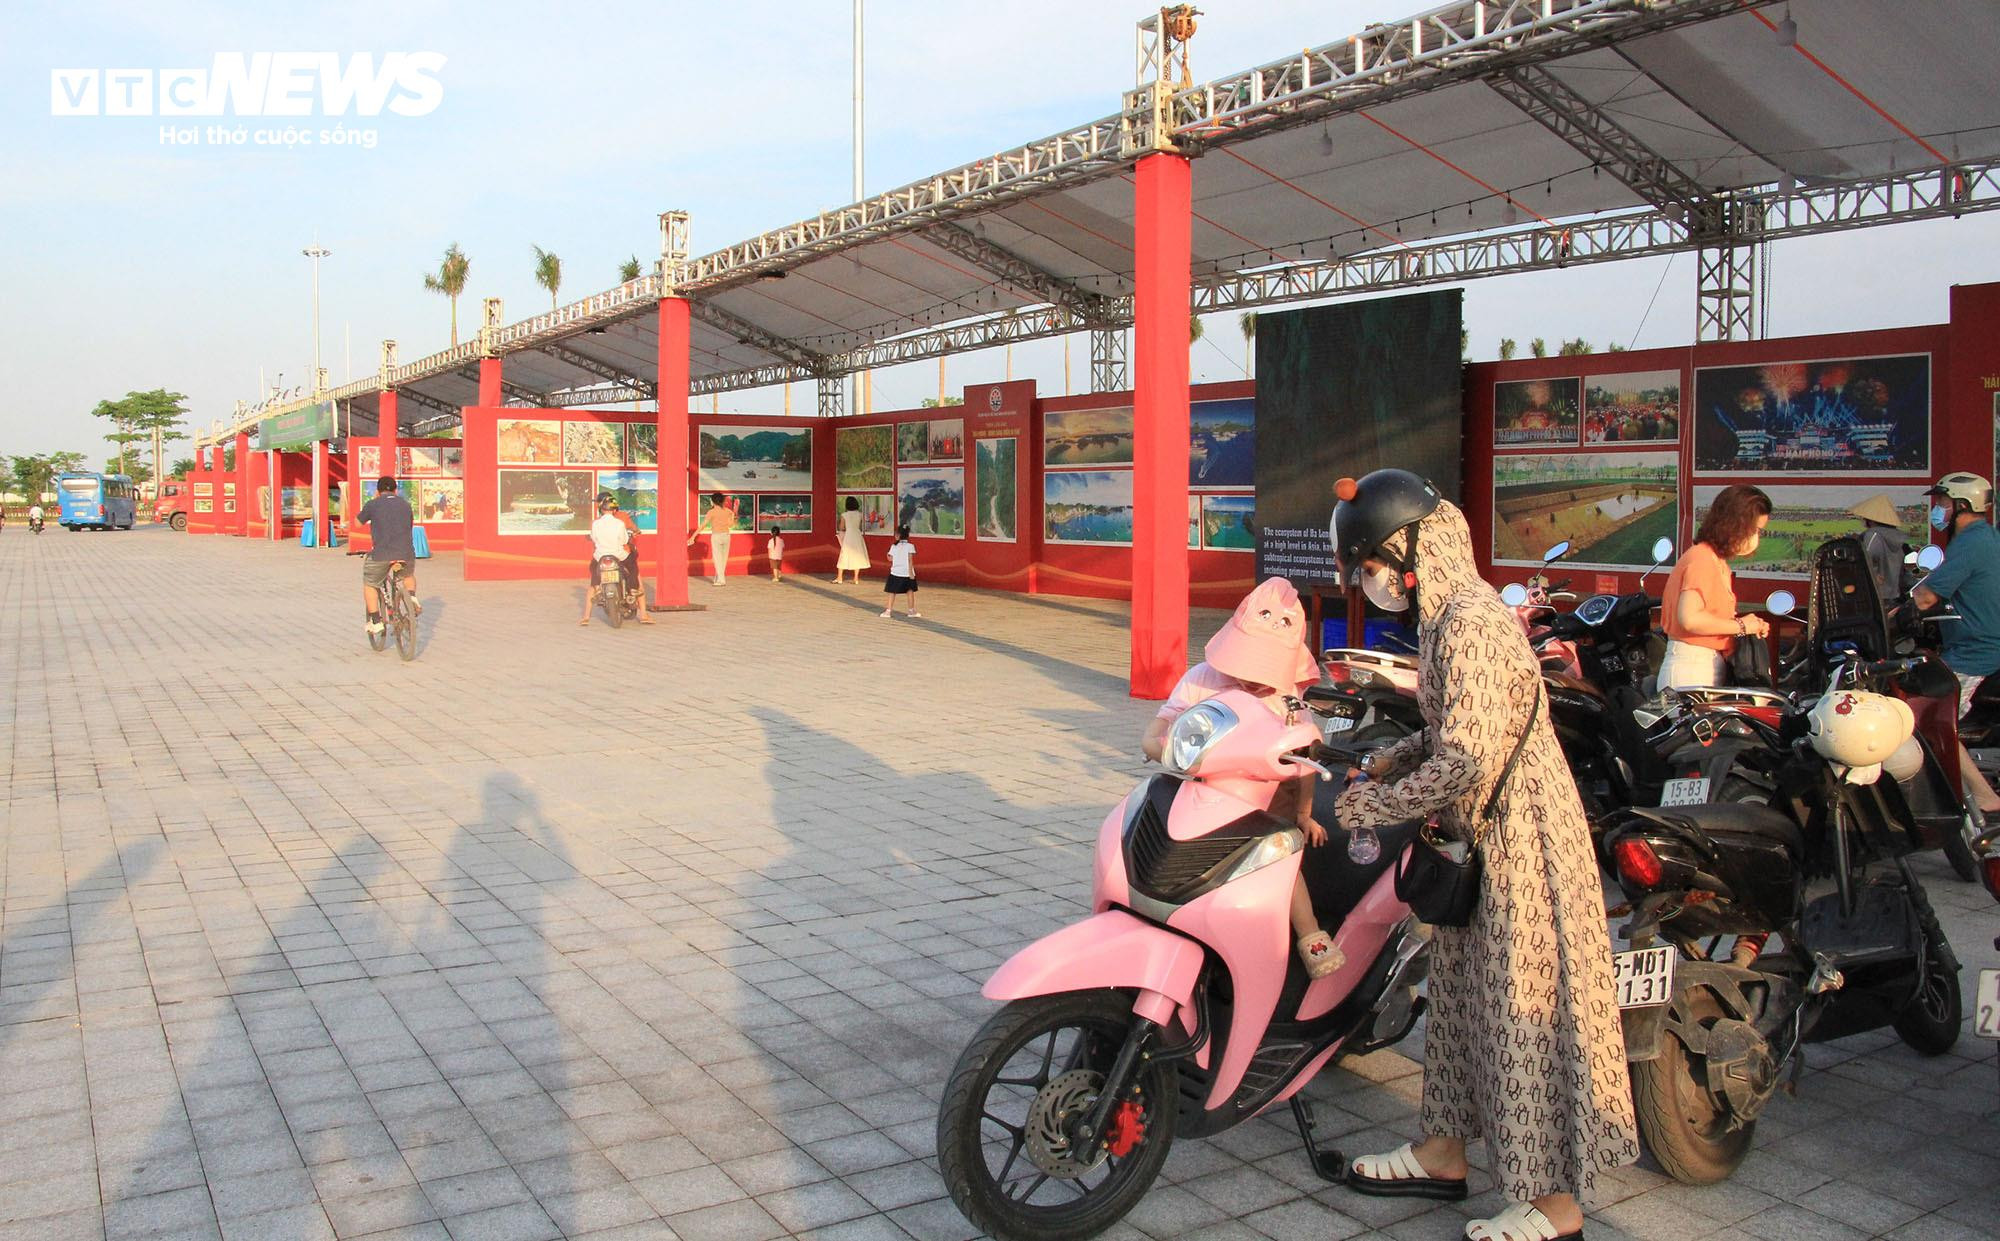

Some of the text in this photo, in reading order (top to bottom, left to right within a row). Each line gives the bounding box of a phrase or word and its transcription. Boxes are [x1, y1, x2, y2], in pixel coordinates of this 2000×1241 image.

[1264, 527, 1274, 536] The
[1275, 528, 1302, 538] ecosystem
[1303, 528, 1309, 537] of
[1318, 529, 1331, 539] Lon
[1275, 540, 1286, 551] high
[1287, 541, 1300, 550] level
[1301, 541, 1307, 550] in
[1264, 552, 1292, 564] subtropical
[1293, 554, 1324, 566] ecosystems
[1264, 565, 1288, 578] including
[1289, 568, 1309, 579] primary
[1310, 568, 1321, 578] rain
[1616, 976, 1667, 1004] 1.31
